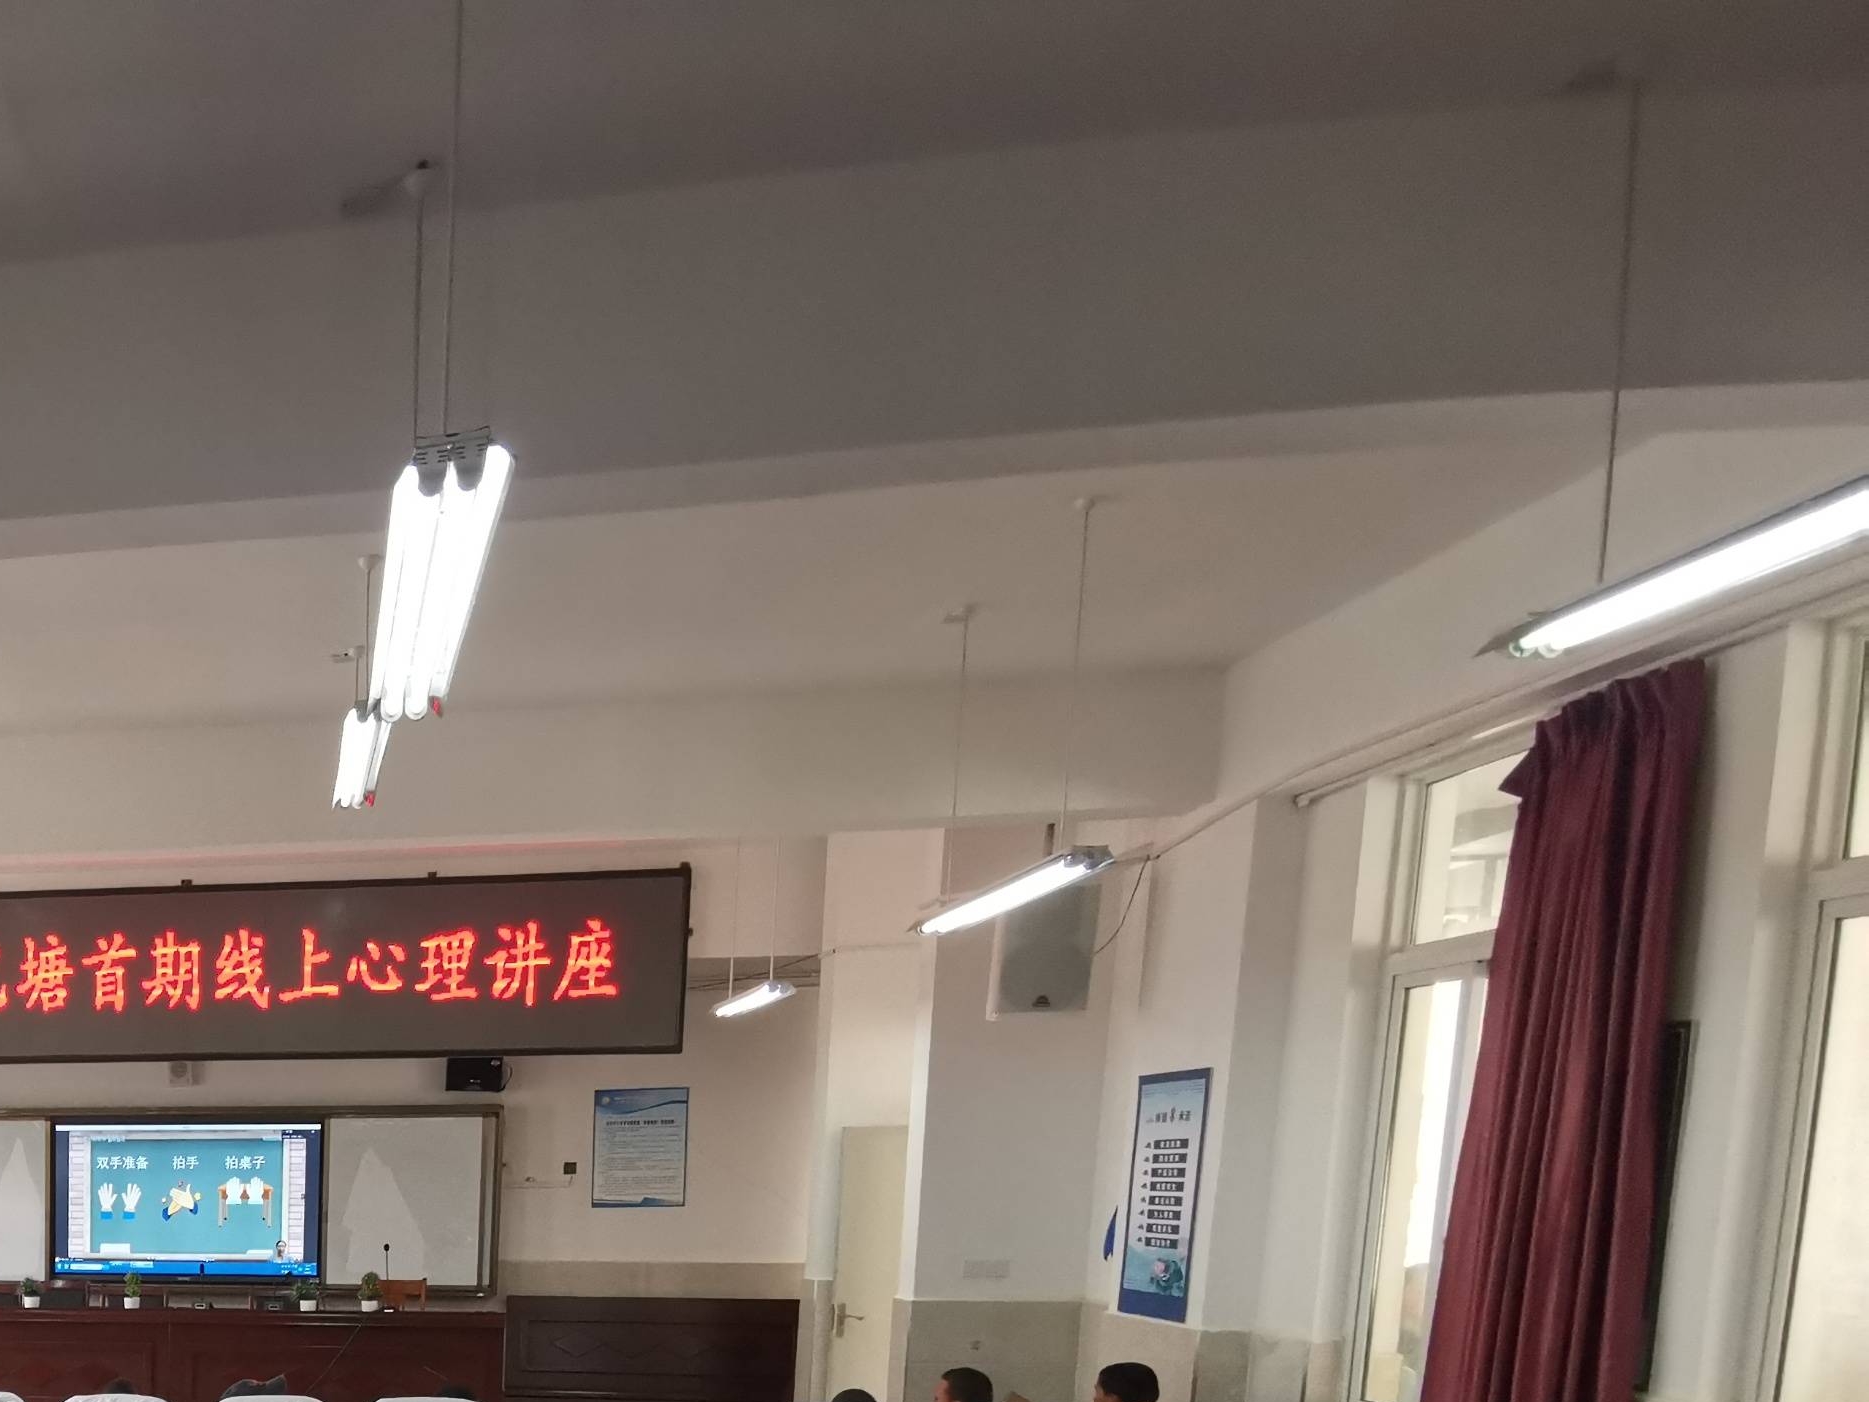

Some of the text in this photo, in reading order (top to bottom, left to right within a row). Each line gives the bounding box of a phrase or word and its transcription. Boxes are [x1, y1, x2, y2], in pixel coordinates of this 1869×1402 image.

[96, 1156, 266, 1169] 双手准备 拍手 拍桌子
